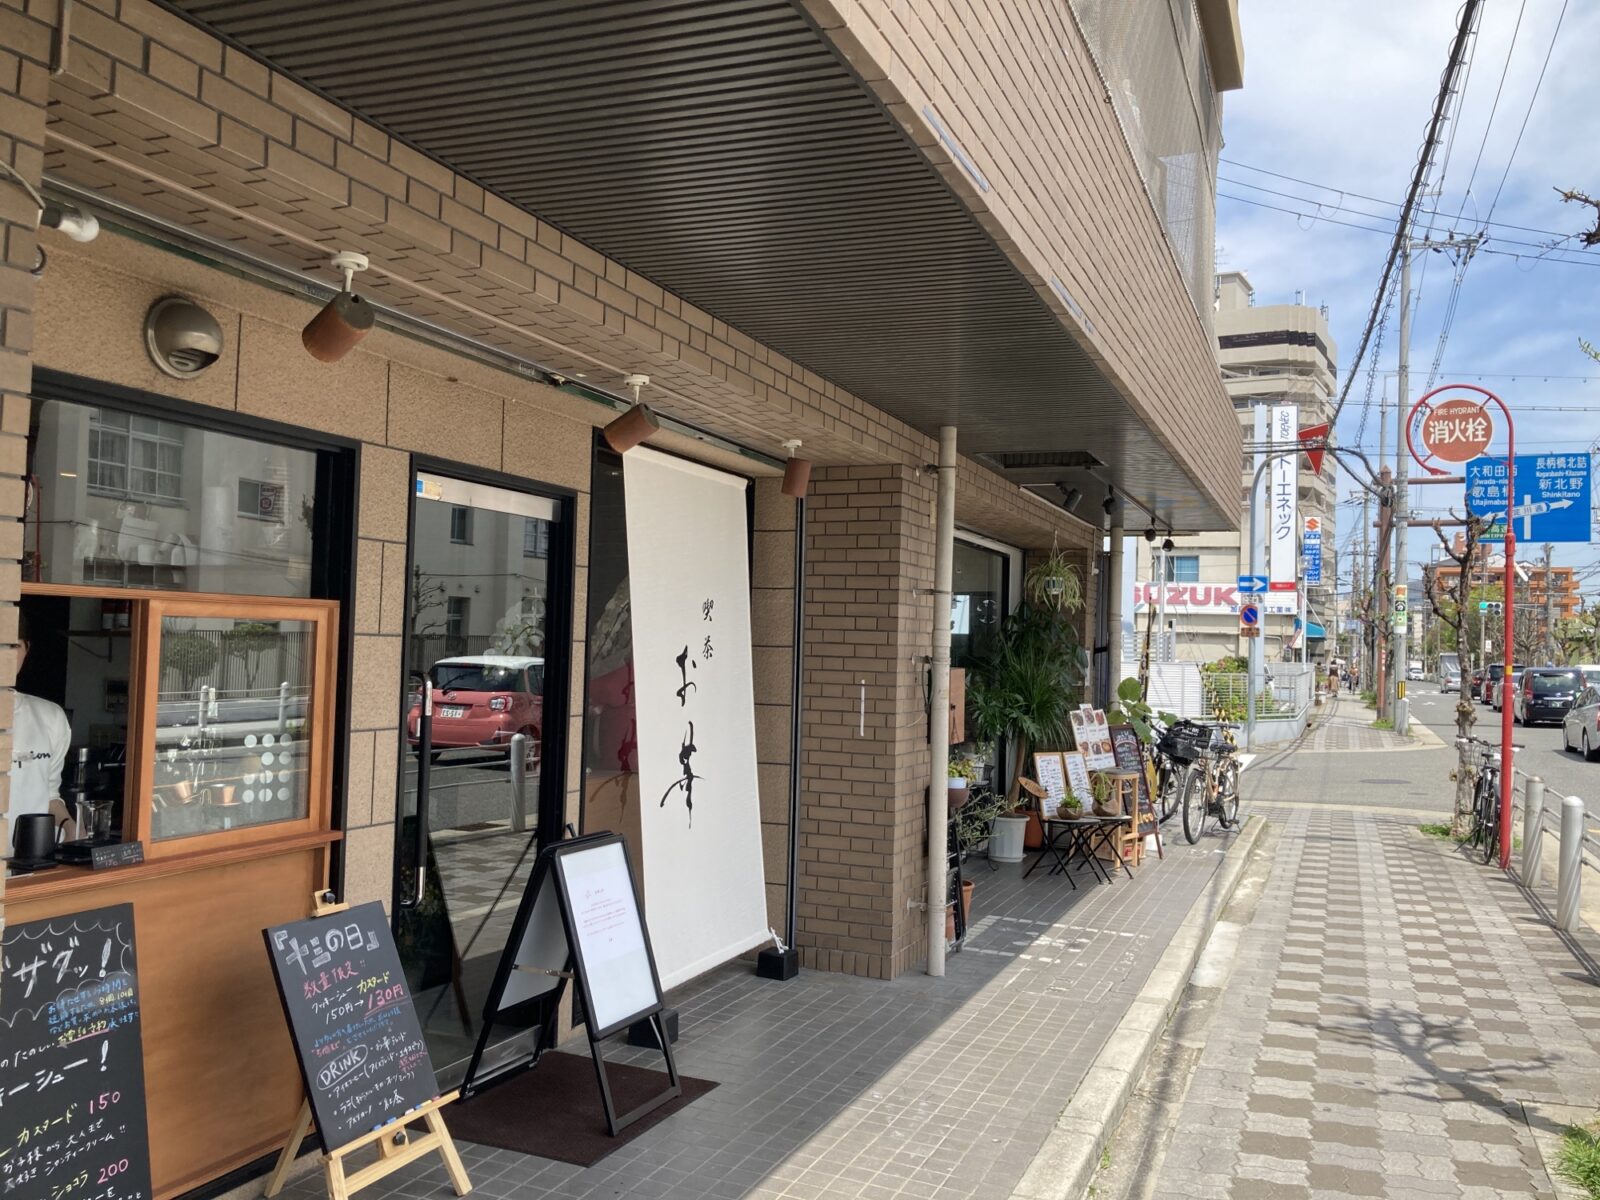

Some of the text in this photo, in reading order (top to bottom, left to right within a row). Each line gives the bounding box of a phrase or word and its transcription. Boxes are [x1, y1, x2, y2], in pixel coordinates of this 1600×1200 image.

[1434, 406, 1481, 416] FIRE HYDRANT
[1429, 417, 1488, 444] 消火栓
[1536, 456, 1587, 469] 長柄橋北詰
[1539, 477, 1584, 490] 新北野
[1276, 455, 1292, 541] トーエネック
[1135, 585, 1239, 606] UZUK
[702, 597, 714, 660] 喫茶
[4, 935, 112, 999] ザグッ!
[355, 970, 391, 994] カスタード
[325, 983, 404, 1025] 150円 130円
[320, 1048, 361, 1086] DRINK
[16, 1091, 121, 1148] カスタード 150
[96, 1158, 129, 1185] 200
